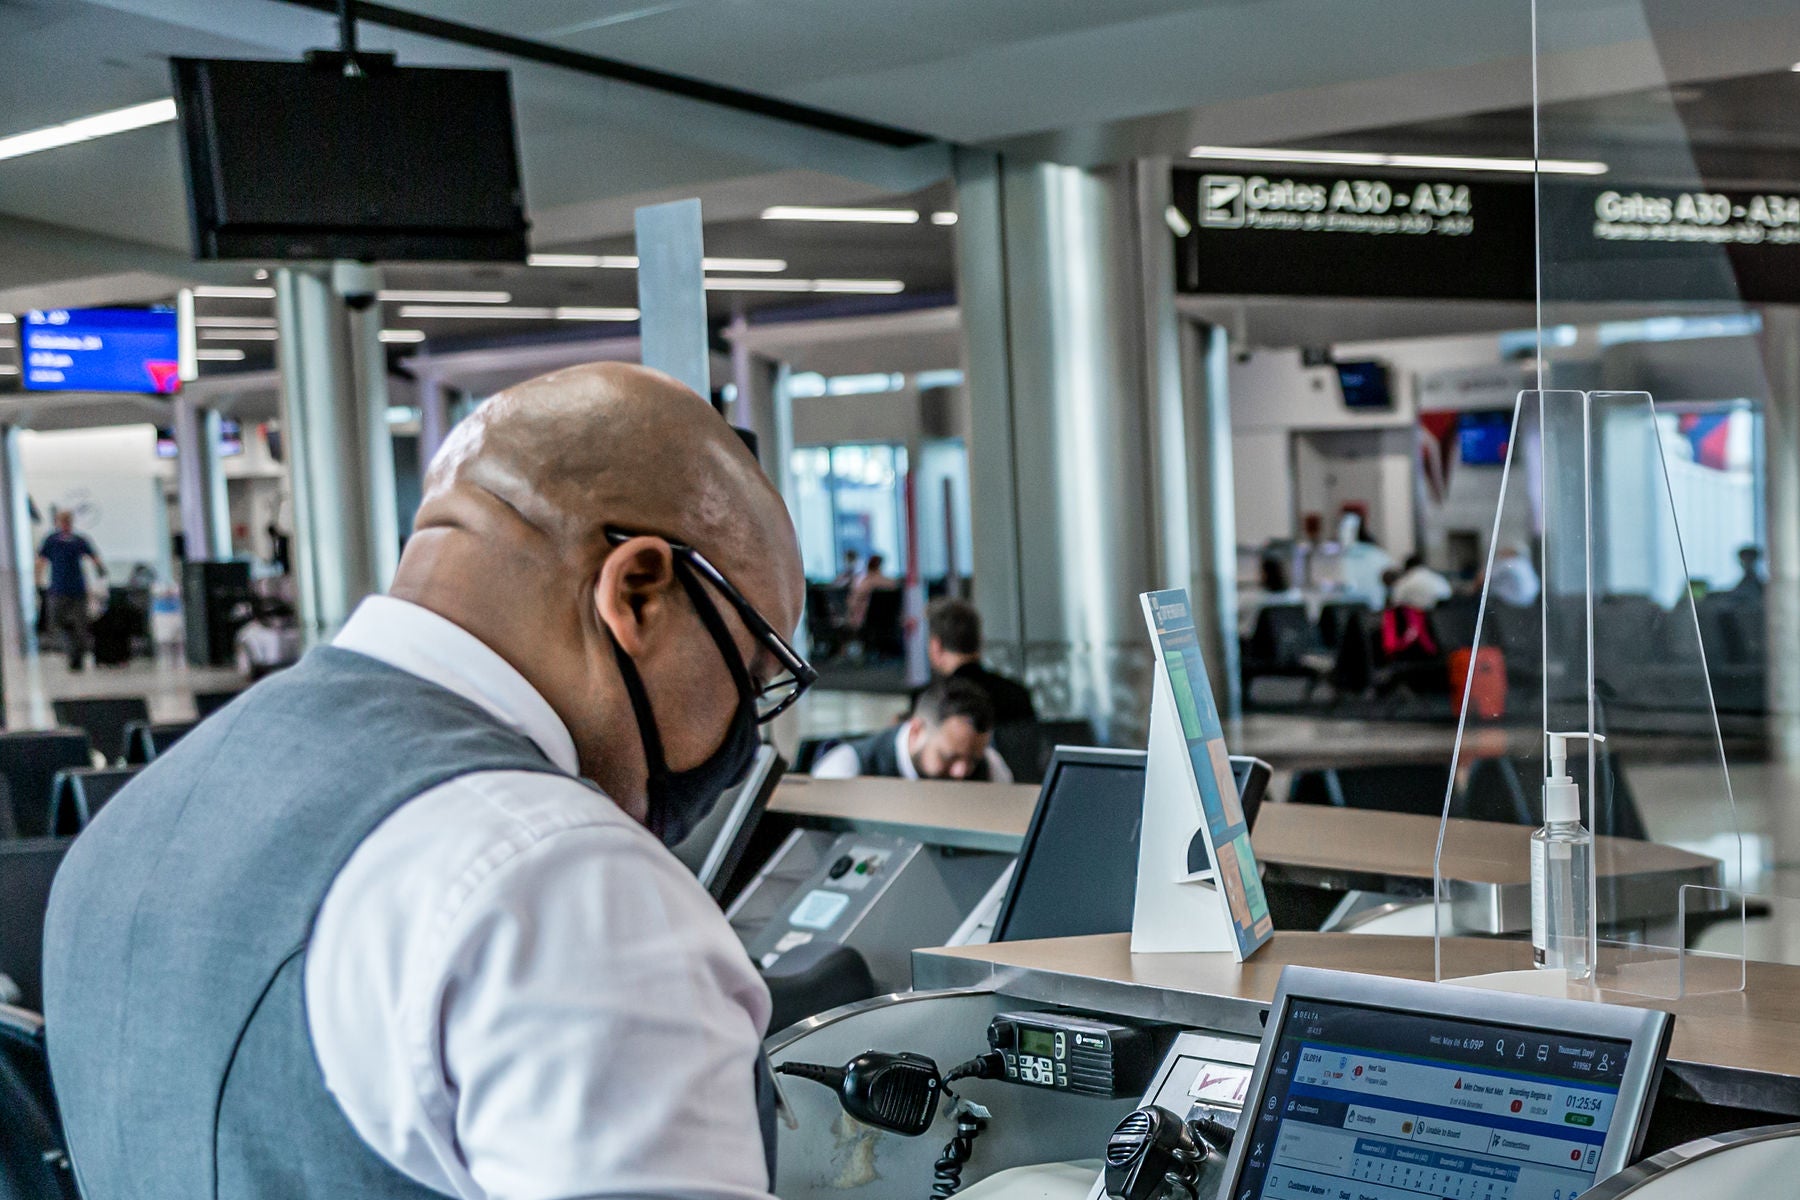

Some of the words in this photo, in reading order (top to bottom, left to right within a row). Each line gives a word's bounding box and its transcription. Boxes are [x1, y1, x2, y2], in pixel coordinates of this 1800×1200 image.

[1248, 176, 1328, 212] Gates
[1330, 180, 1393, 215] A30
[1410, 183, 1473, 216] A34
[1596, 191, 1672, 223] Gates
[1674, 193, 1731, 225] A30
[1748, 195, 1800, 227] A34
[1298, 1011, 1319, 1020] DELTA
[1462, 1038, 1484, 1050] 6:09P
[1295, 1103, 1319, 1114] Customers
[1564, 1094, 1602, 1111] 01:25:54
